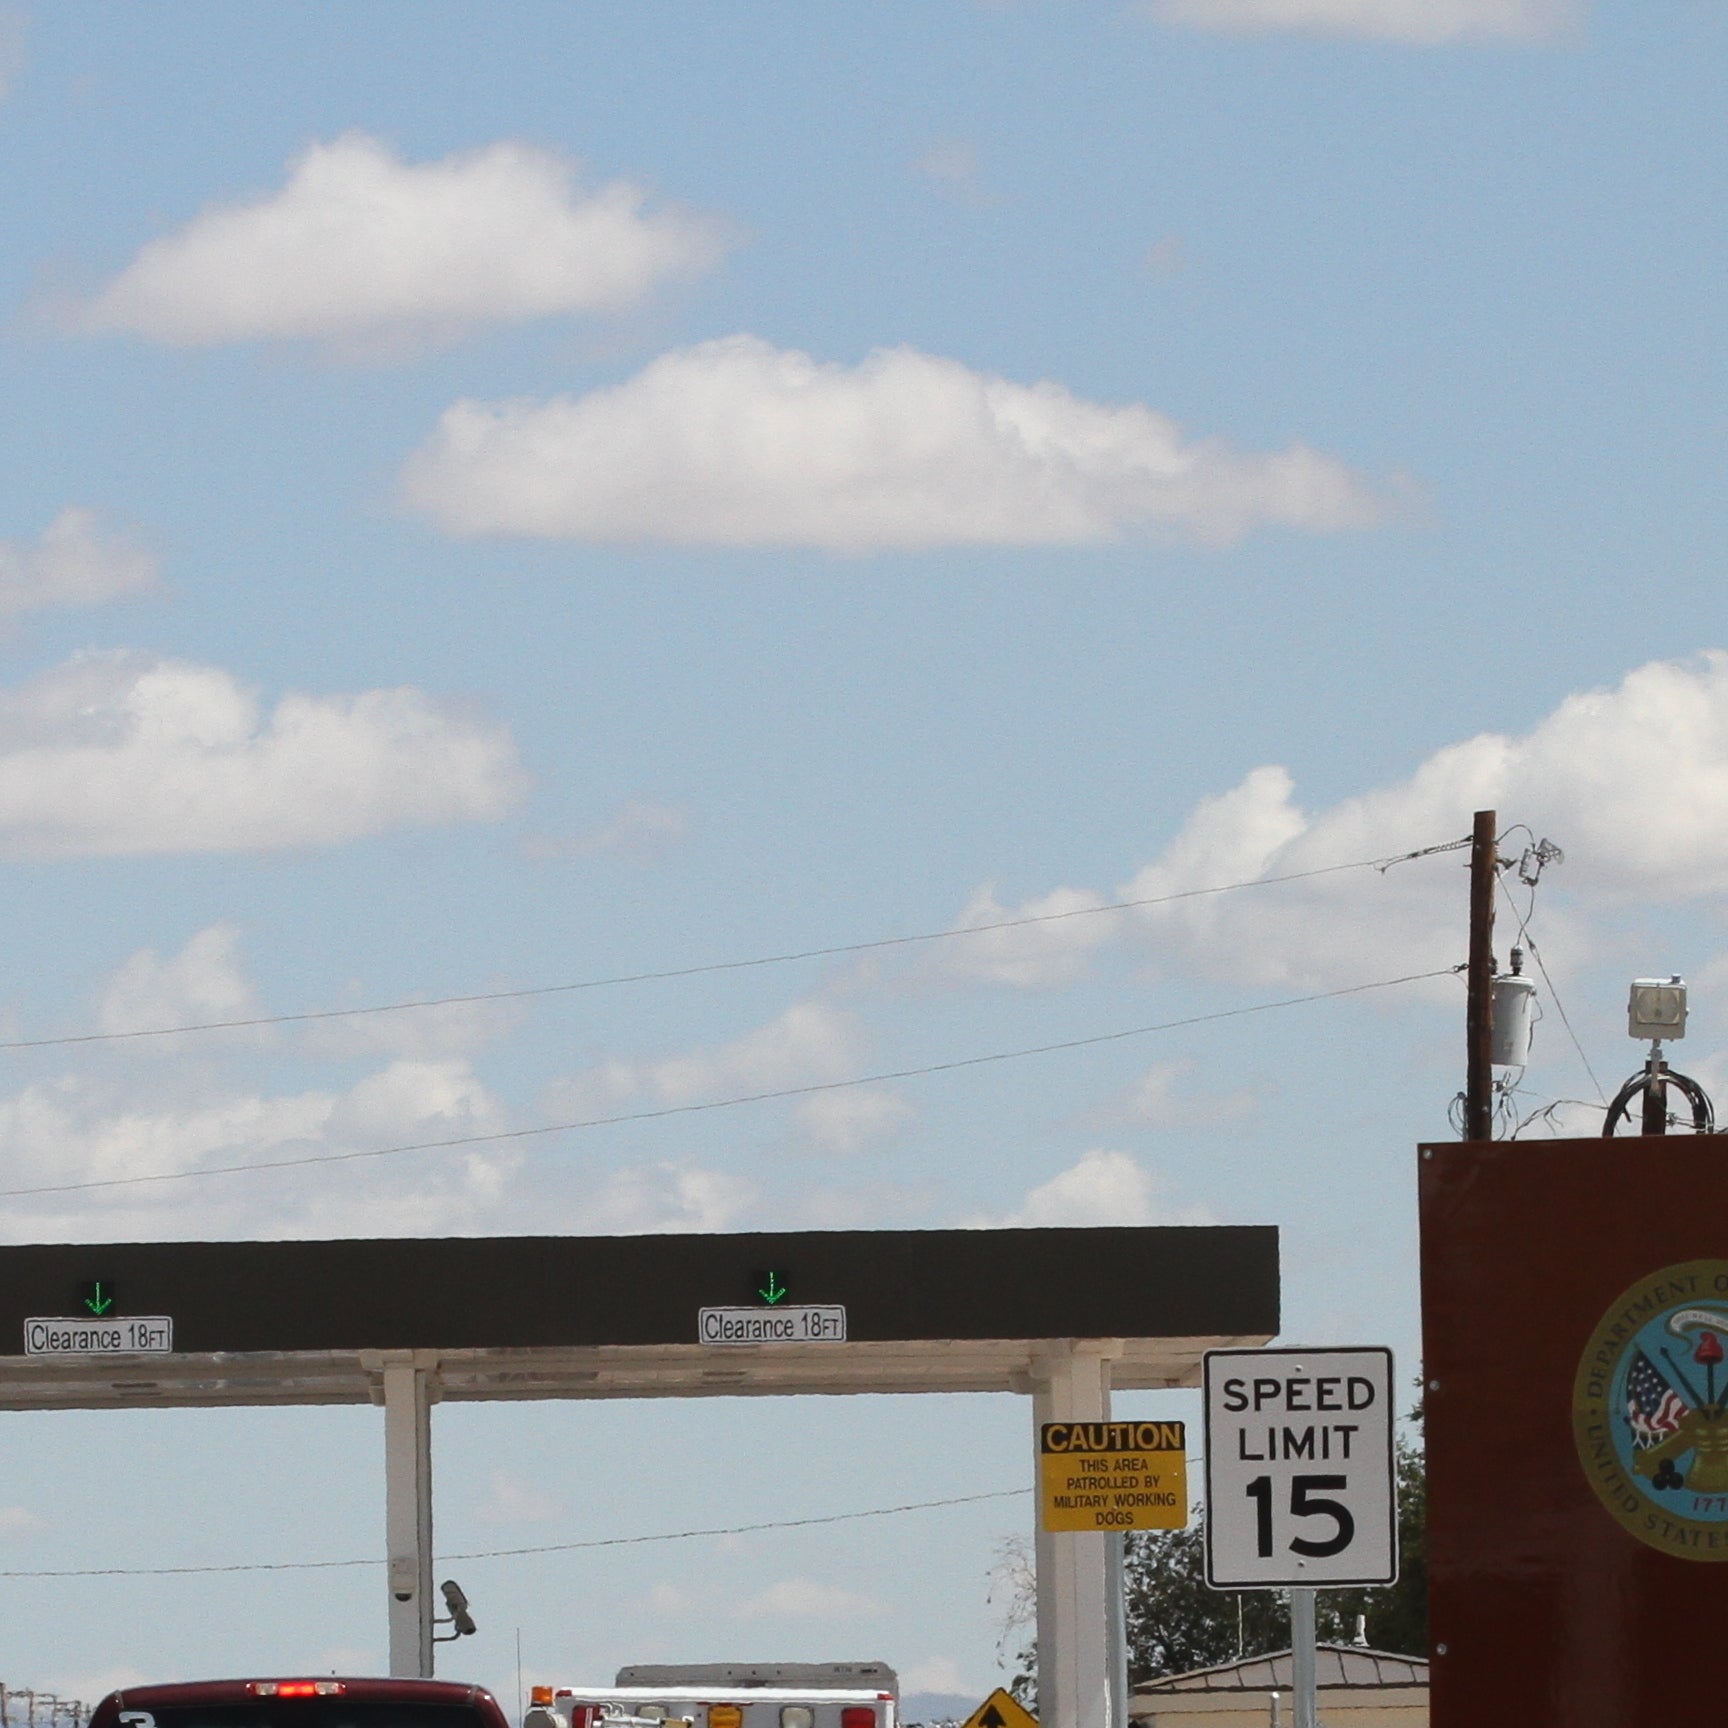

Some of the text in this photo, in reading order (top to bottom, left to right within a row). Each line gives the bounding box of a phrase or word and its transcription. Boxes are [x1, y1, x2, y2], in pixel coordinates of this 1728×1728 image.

[31, 1324, 121, 1351] Clearance
[705, 1313, 794, 1340] Clearance
[1587, 1275, 1700, 1399] DEPARTMENT
[1222, 1376, 1376, 1413] SPEED
[1046, 1422, 1181, 1452] CAUTION
[1238, 1425, 1359, 1461] LIMIT
[1079, 1458, 1149, 1473] THIS AREA
[1067, 1475, 1160, 1491] PATROLLED BY
[1054, 1493, 1177, 1509] MILITARY WORKING
[1095, 1511, 1134, 1525] DOGS
[1245, 1474, 1355, 1559] 15
